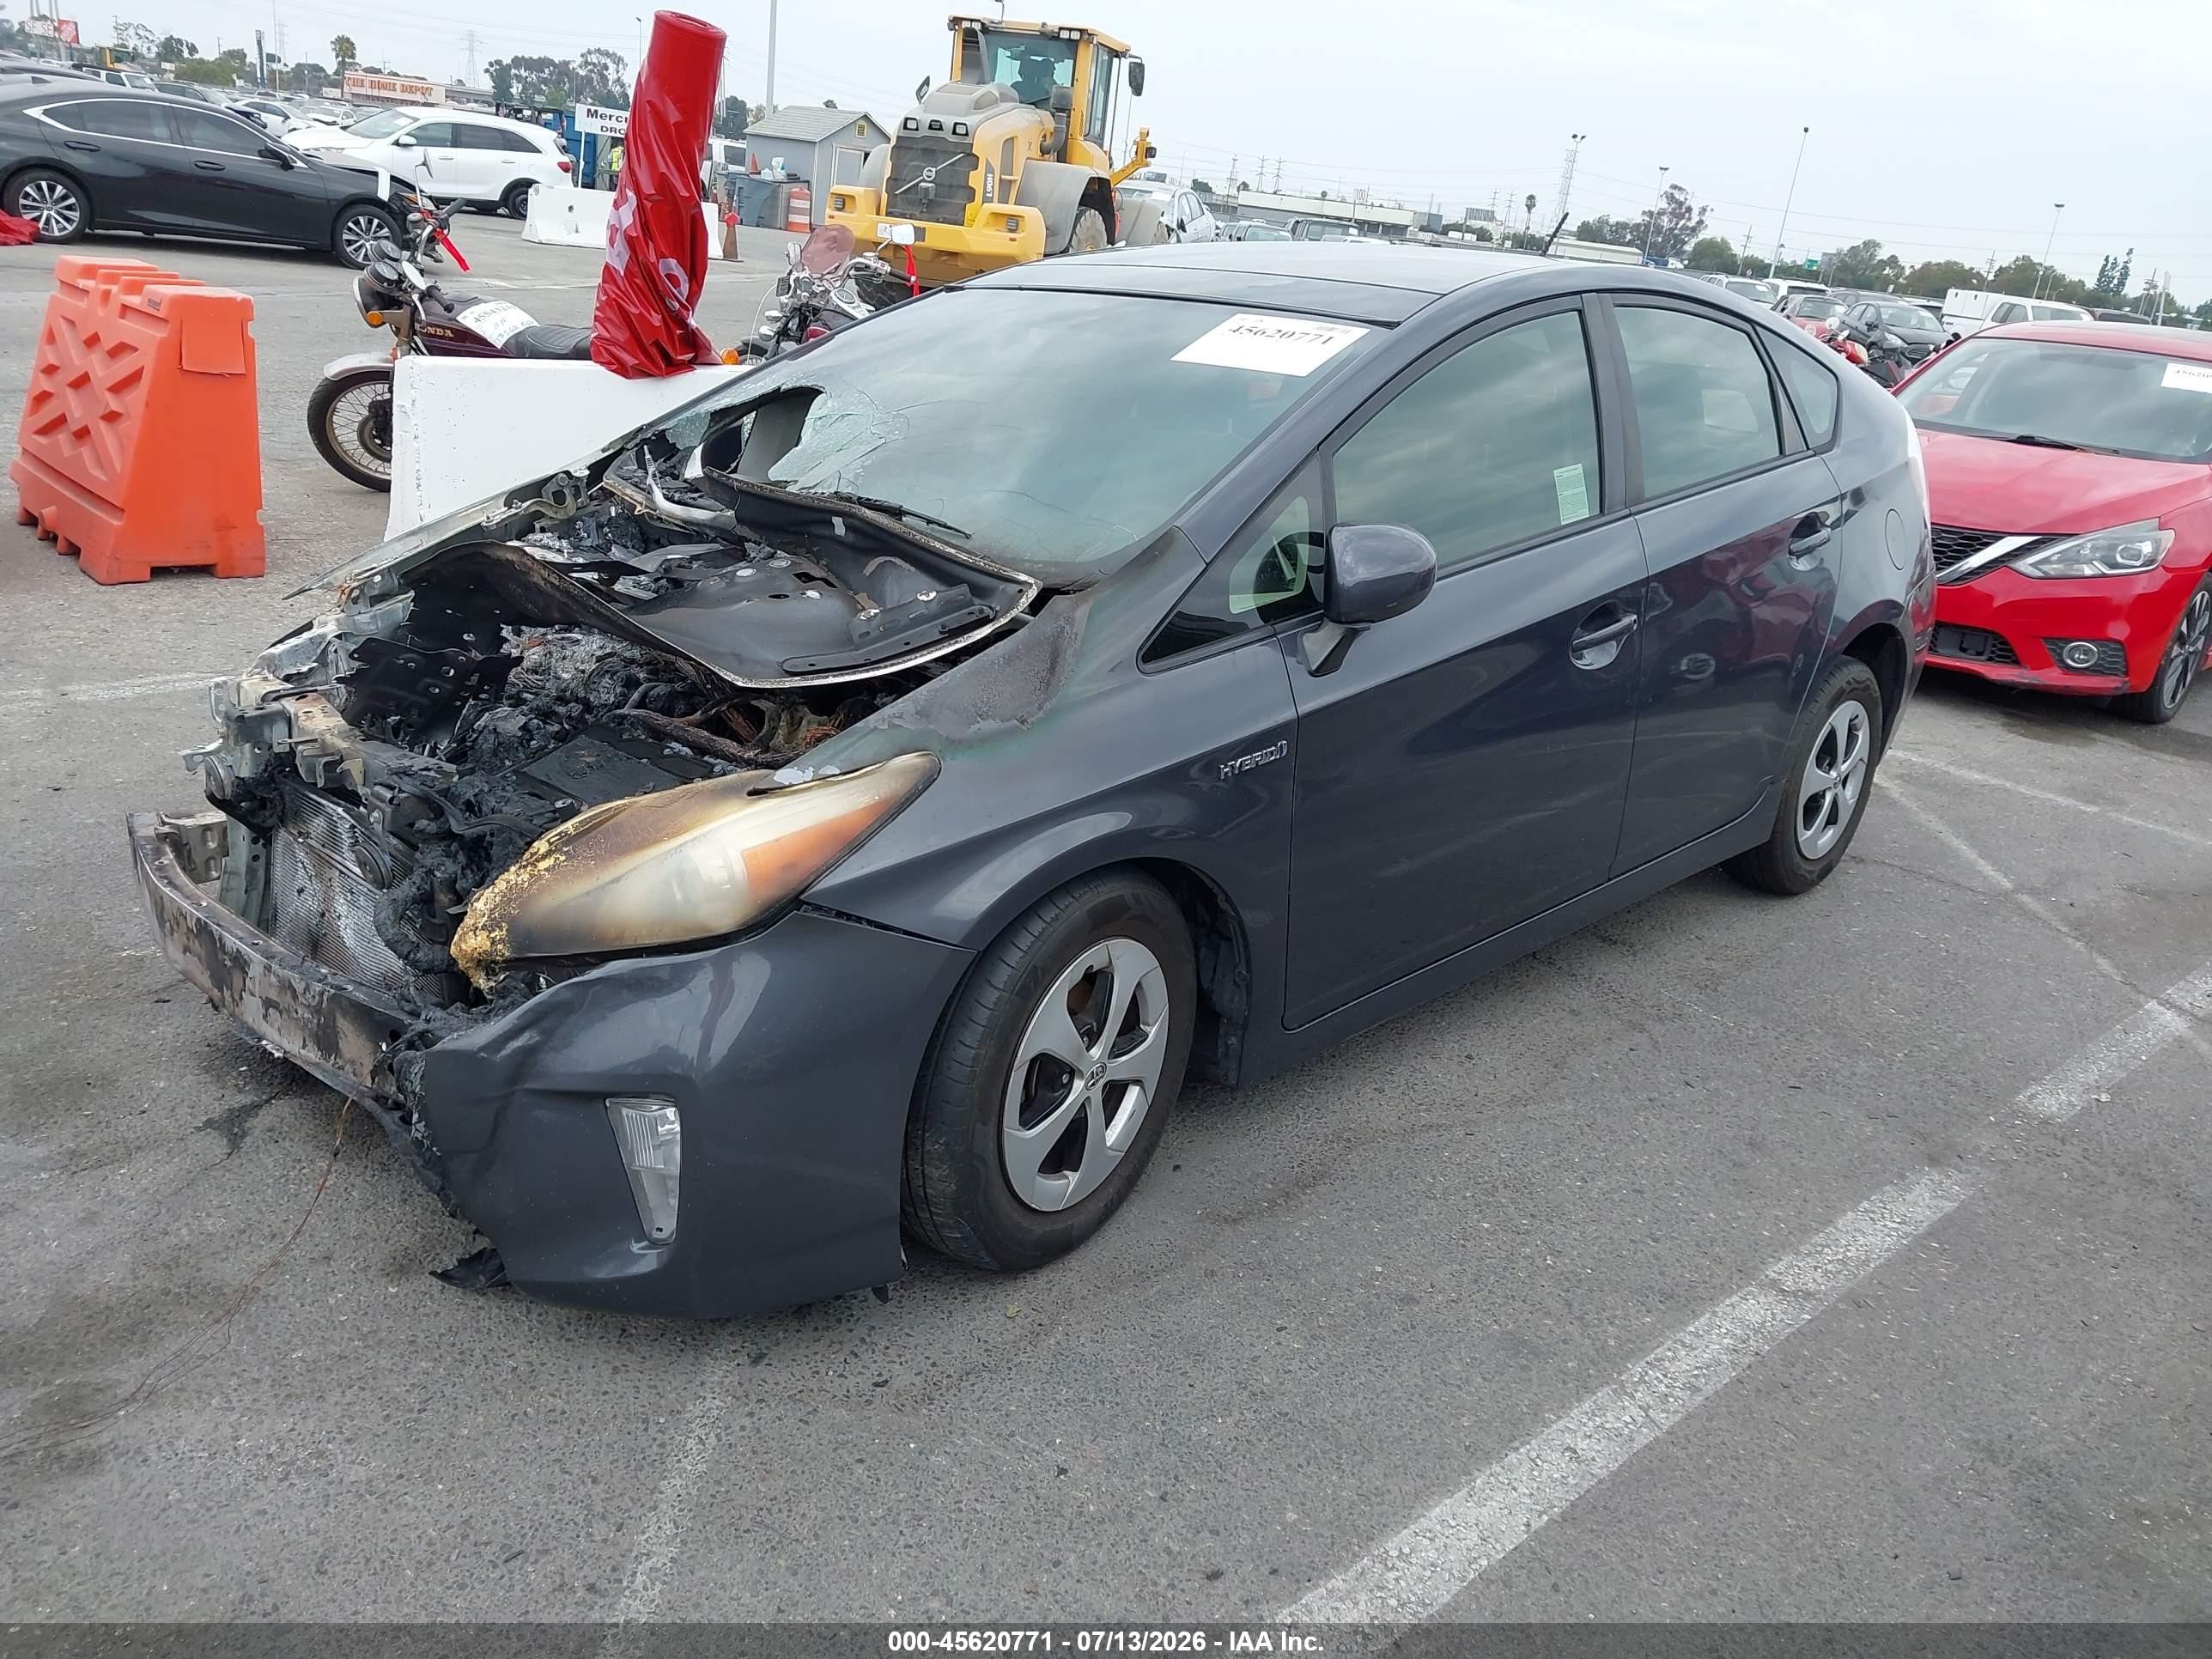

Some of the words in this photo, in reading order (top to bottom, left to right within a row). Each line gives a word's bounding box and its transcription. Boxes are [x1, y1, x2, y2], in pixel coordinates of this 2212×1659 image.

[344, 76, 365, 88] THE
[368, 80, 397, 92] HOME
[399, 83, 434, 97] DEPOT
[1229, 325, 1335, 344] 45620771
[1218, 740, 1287, 780] HYBRID
